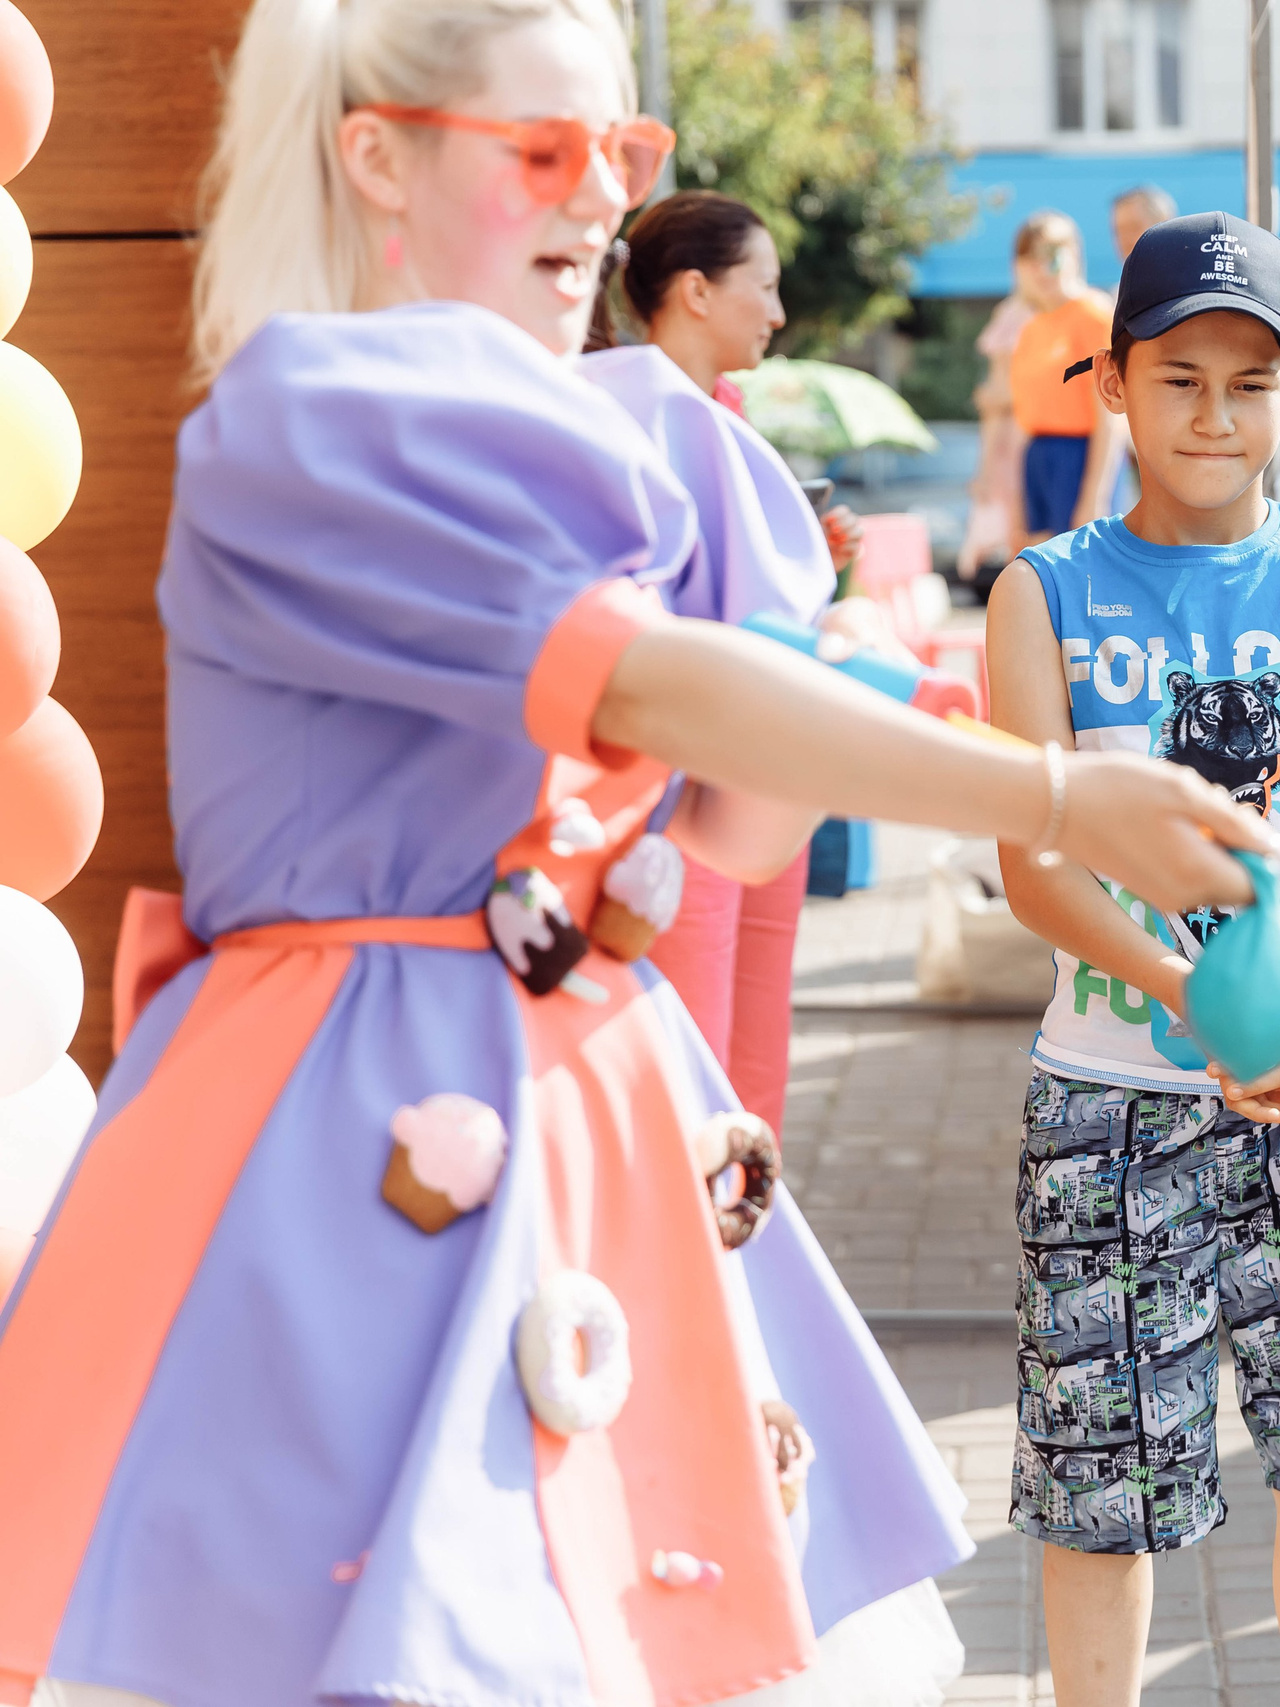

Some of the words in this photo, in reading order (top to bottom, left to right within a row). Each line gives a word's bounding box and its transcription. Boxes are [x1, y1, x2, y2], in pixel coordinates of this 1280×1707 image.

[1210, 233, 1239, 243] KEEP
[1200, 241, 1248, 258] CALM
[1215, 253, 1234, 261] AND
[1213, 260, 1235, 274] BE
[1200, 272, 1248, 286] AWESOME
